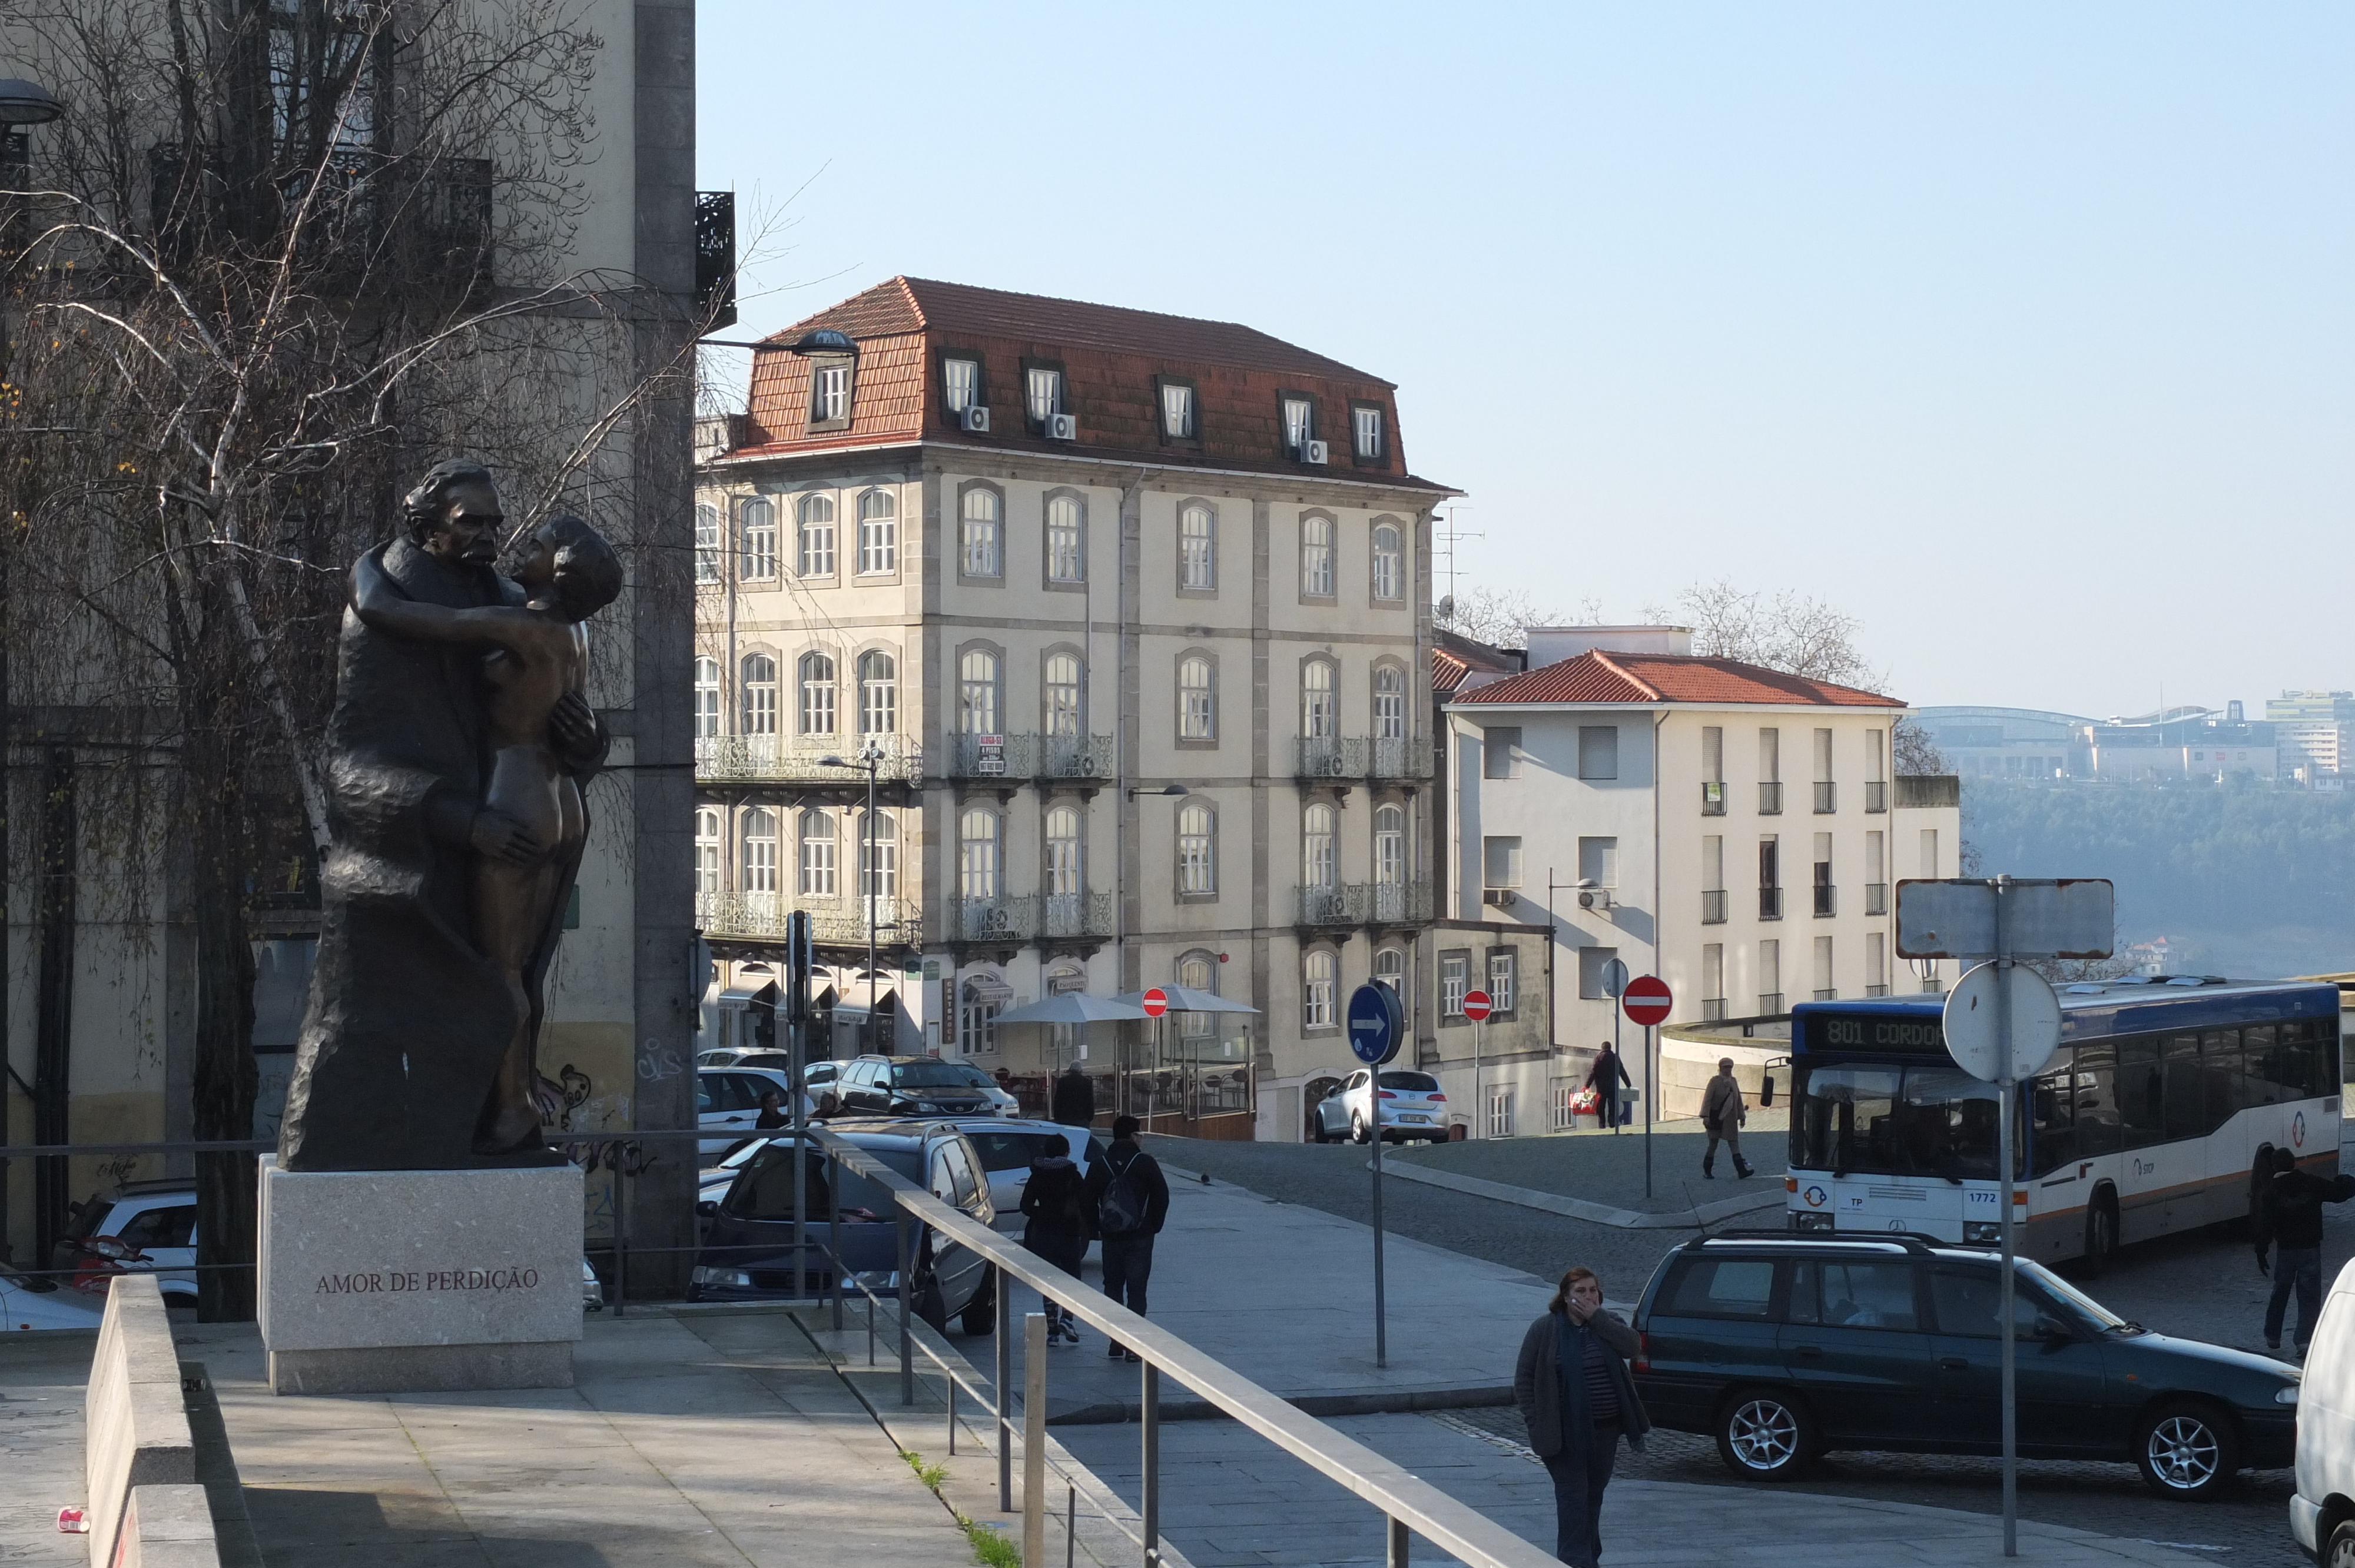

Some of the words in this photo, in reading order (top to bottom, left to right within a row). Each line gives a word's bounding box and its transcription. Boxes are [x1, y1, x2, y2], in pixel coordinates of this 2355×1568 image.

[1827, 1020, 1865, 1044] 801
[1969, 1193, 1996, 1203] 1772
[315, 1273, 384, 1294] AMOR
[389, 1272, 420, 1292] DE
[426, 1266, 539, 1293] PERDIÇÃO
